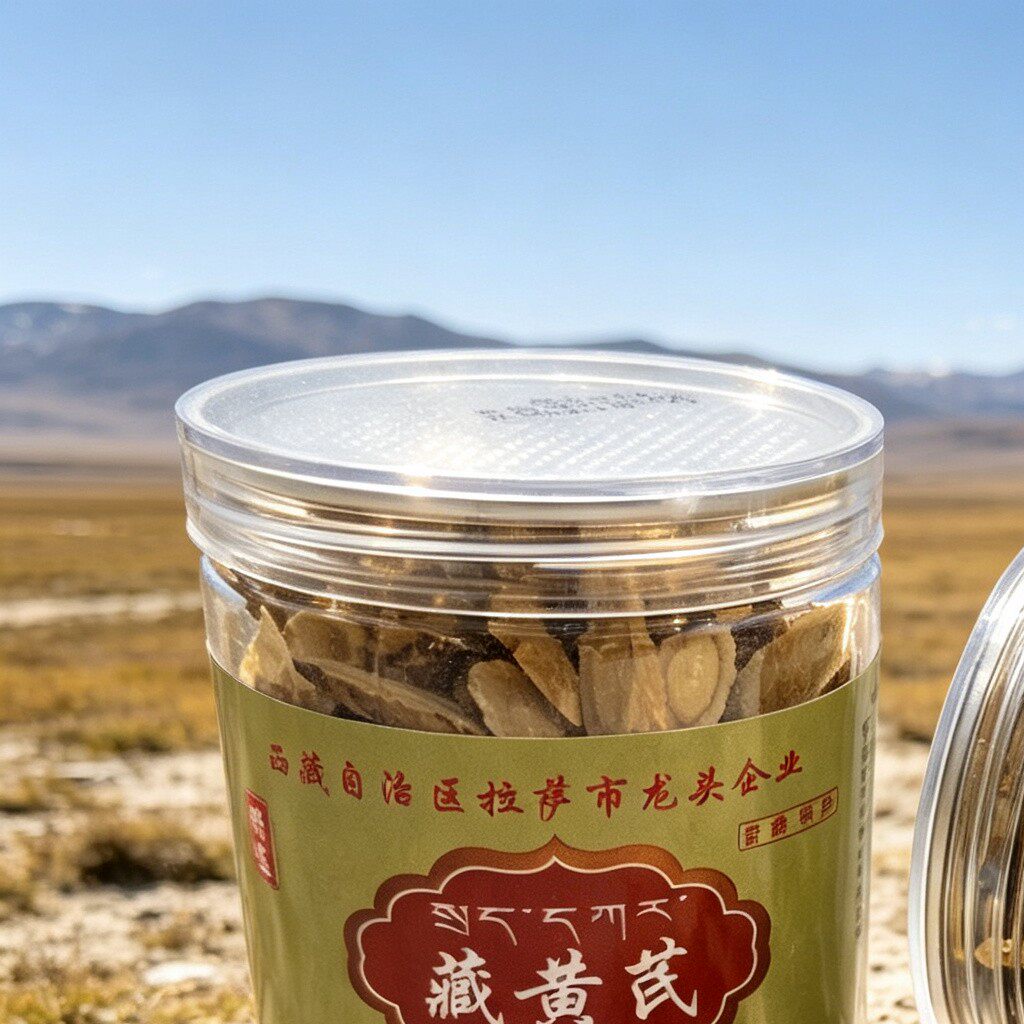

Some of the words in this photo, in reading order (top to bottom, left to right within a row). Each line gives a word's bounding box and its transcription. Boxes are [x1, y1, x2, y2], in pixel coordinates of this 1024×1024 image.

[268, 742, 803, 822] 西藏自治区拉萨市龙头企业
